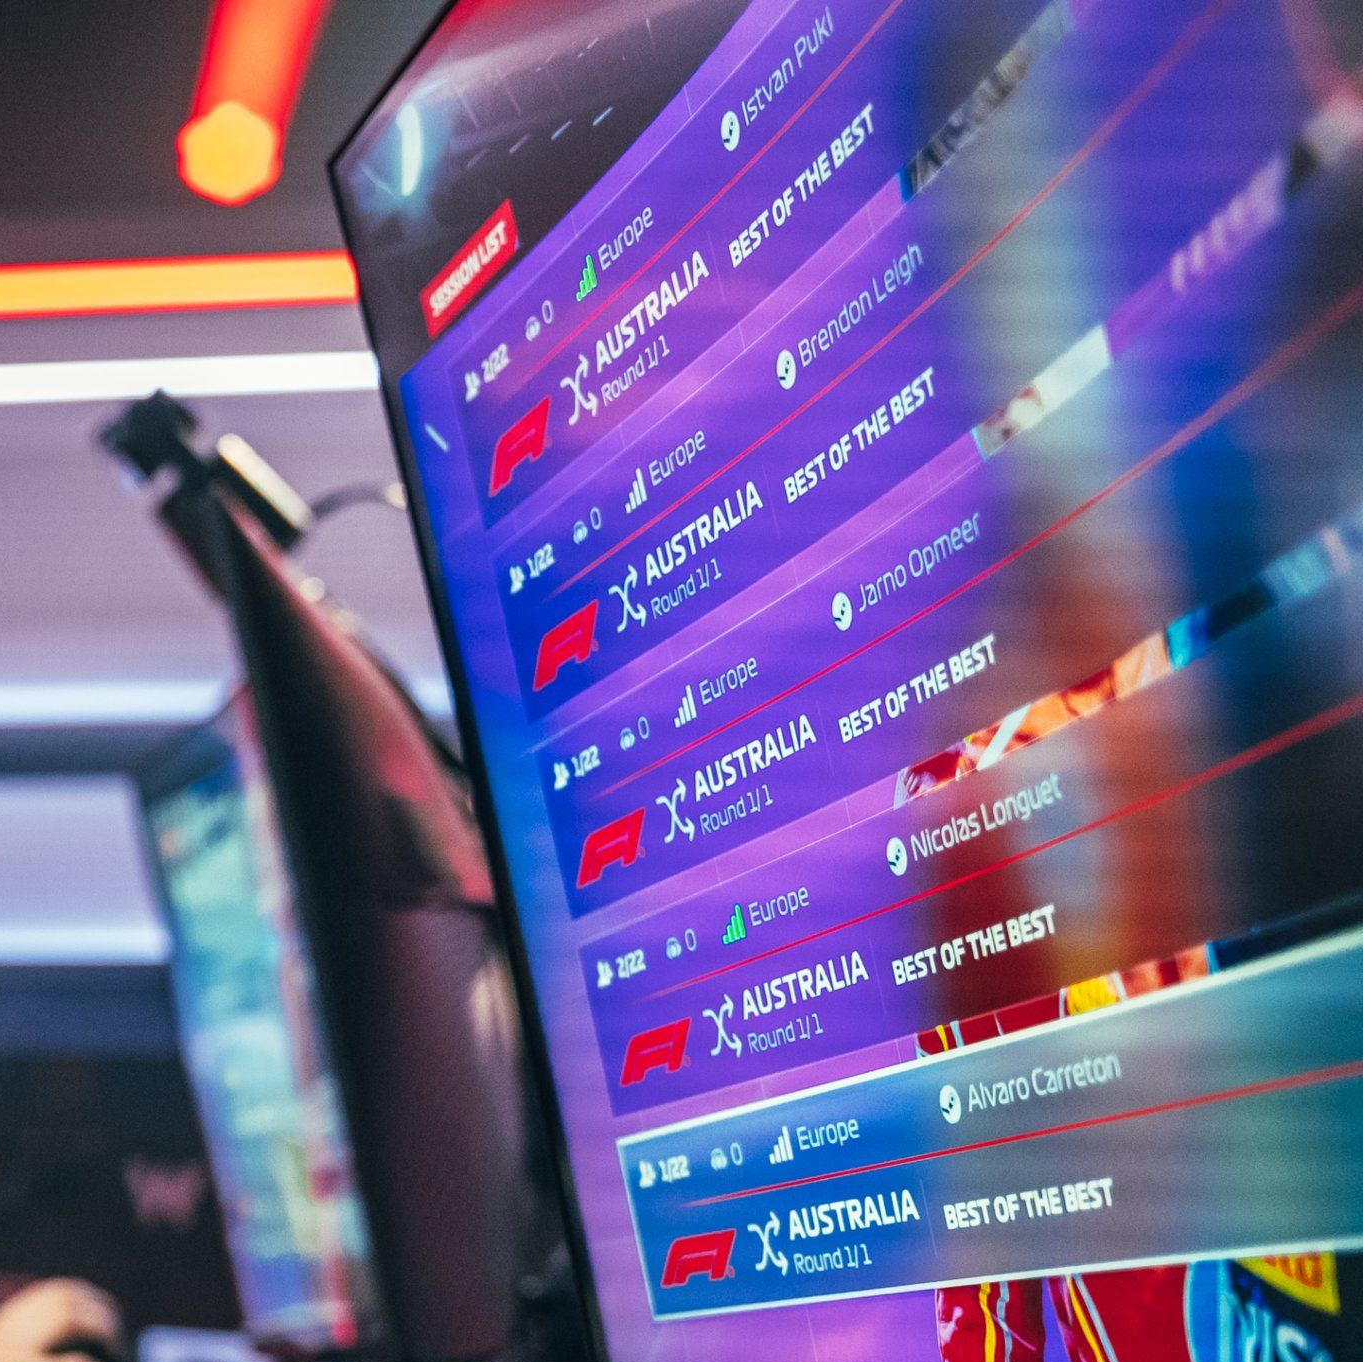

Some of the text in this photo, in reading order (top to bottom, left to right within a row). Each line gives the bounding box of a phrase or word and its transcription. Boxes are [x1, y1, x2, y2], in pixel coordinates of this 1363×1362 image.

[597, 206, 654, 271] Europe
[741, 56, 795, 126] Istvan
[794, 7, 835, 69] Puki
[429, 220, 508, 318] SESSION LIST
[596, 250, 709, 373] AUSTRALIA
[729, 209, 770, 268] BEST
[772, 187, 796, 227] OF
[794, 150, 832, 202] THE
[830, 103, 875, 170] BEST
[601, 354, 646, 406] Round
[648, 430, 706, 486] Europe
[797, 290, 873, 367] Brendon
[872, 242, 923, 304] Leigh
[645, 480, 763, 586] AUSTRALIA
[783, 452, 827, 504] BEST
[828, 432, 853, 471] OF
[852, 405, 891, 451] THE
[889, 366, 935, 425] BEST
[650, 573, 697, 619] Round
[699, 657, 758, 705] Europe
[859, 564, 907, 613] Jarno
[908, 512, 981, 578] Opmeer
[694, 714, 817, 802] AUSTRALIA
[838, 698, 883, 744] BEST
[884, 687, 910, 719] OF
[910, 663, 949, 704] THE
[948, 632, 996, 685] BEST
[700, 798, 747, 835] Round
[748, 887, 810, 926] Europe
[909, 811, 980, 861] Nicolas
[980, 772, 1063, 832] Longuet
[742, 950, 869, 1020] AUSTRALIA
[891, 947, 937, 986] BEST
[940, 938, 966, 970] OF
[965, 922, 1008, 960] THE
[1005, 904, 1056, 947] BEST
[747, 1020, 796, 1054] Round
[796, 1118, 860, 1151] Europe
[968, 1075, 1030, 1112] Alvaro
[1031, 1052, 1123, 1096] Carreton
[788, 1189, 920, 1241] AUSTRALIA
[943, 1198, 991, 1230] BEST
[993, 1193, 1020, 1223] OF
[1020, 1186, 1063, 1219] THE
[1062, 1177, 1113, 1213] BEST
[794, 1252, 844, 1275] Round
